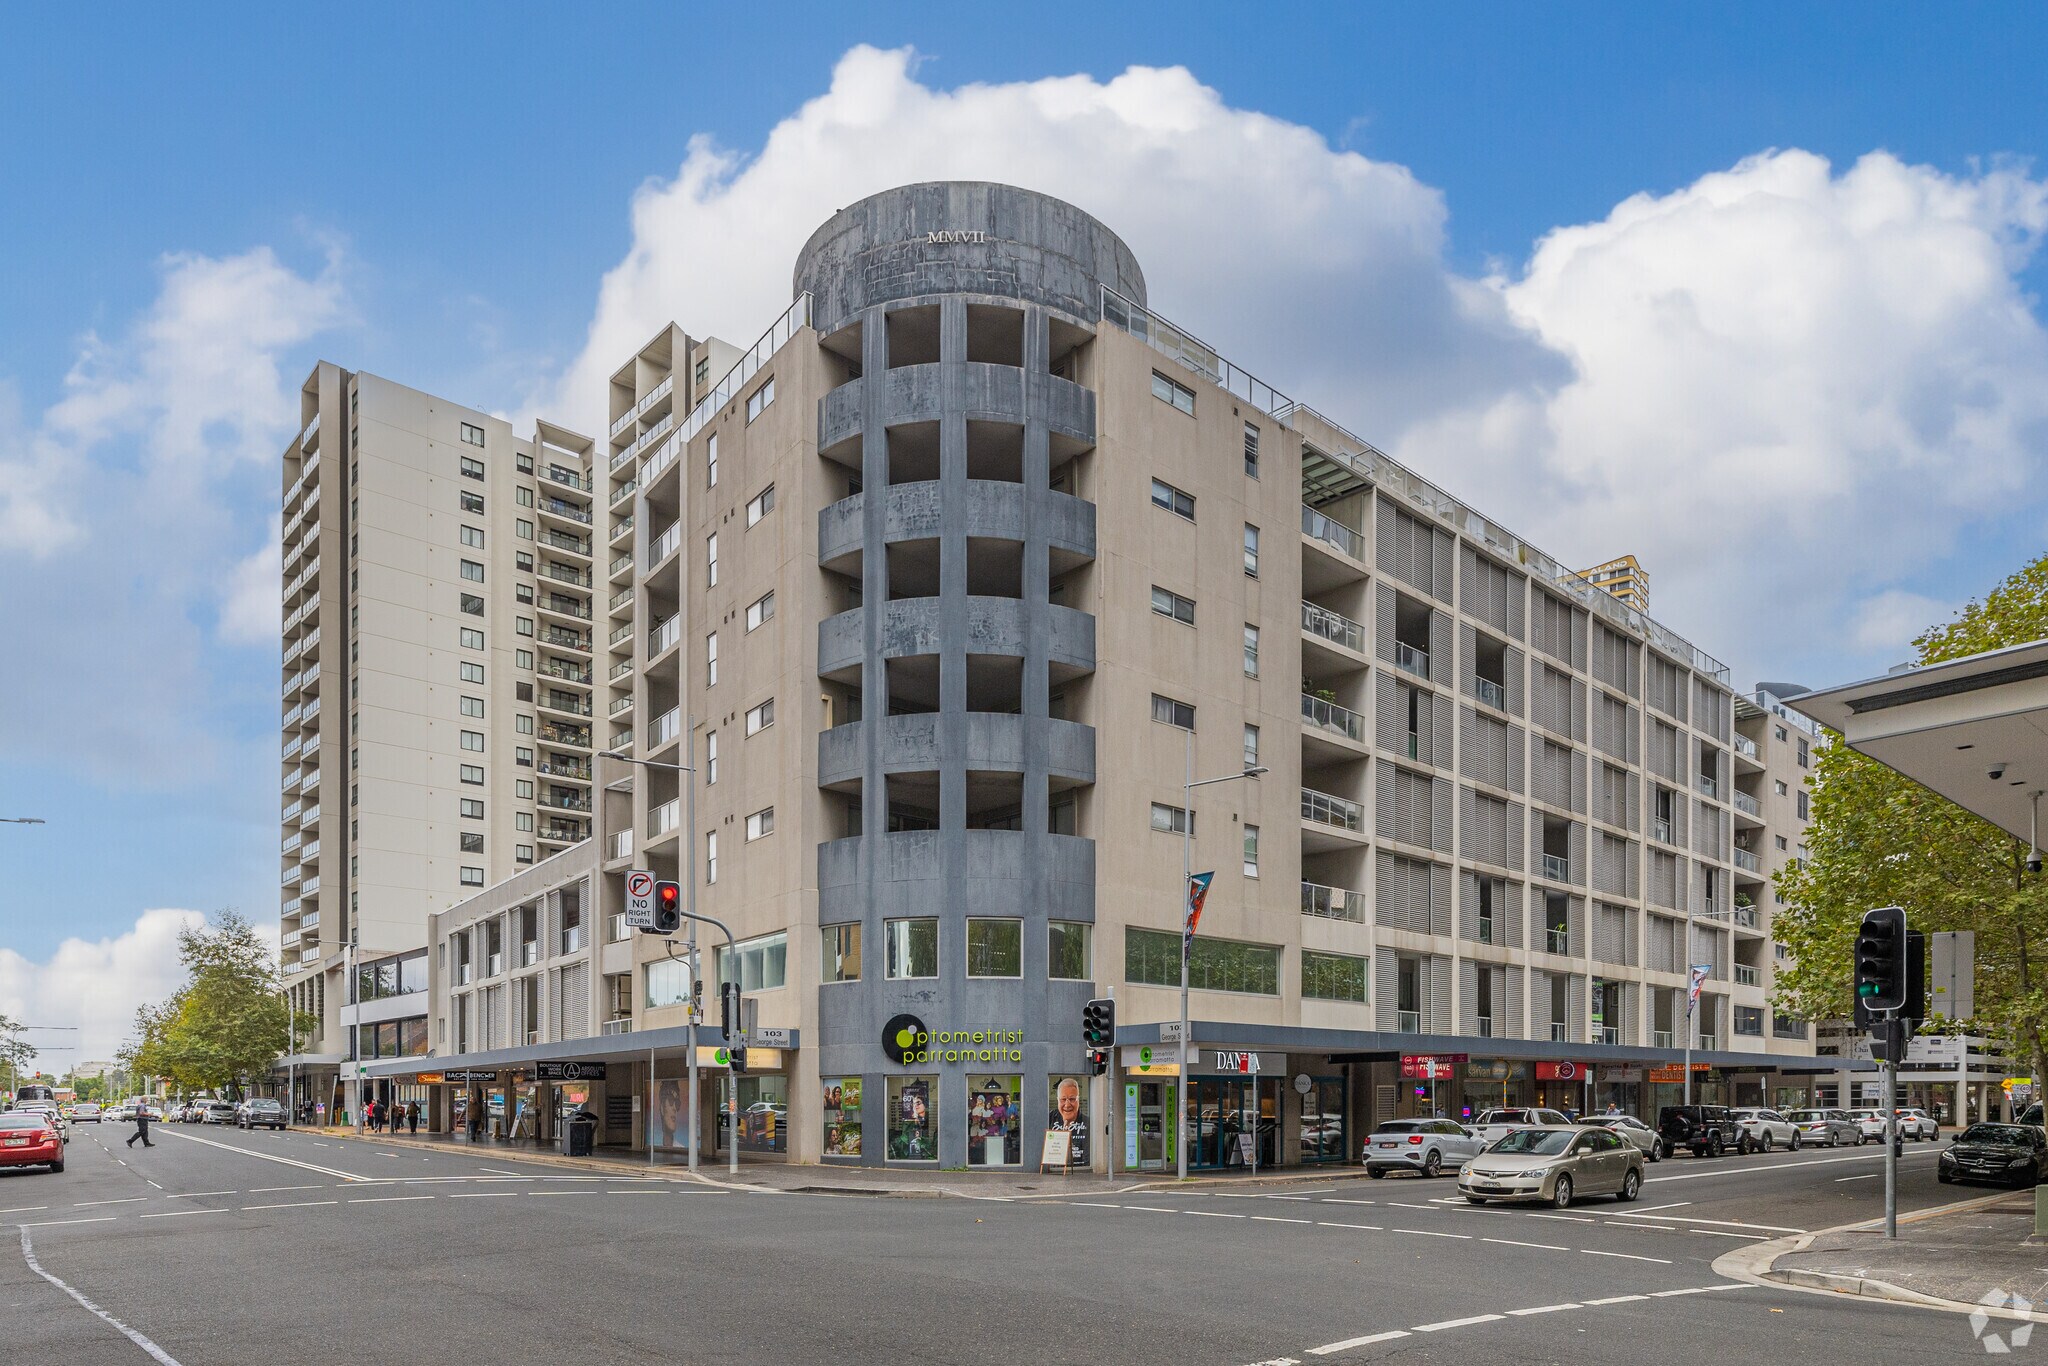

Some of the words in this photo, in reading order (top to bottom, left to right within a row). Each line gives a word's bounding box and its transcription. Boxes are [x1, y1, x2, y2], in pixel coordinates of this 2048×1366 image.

[927, 230, 985, 244] MMVII
[1590, 560, 1628, 575] ALAND
[632, 899, 648, 908] NO
[629, 917, 650, 925] TURN
[756, 1038, 773, 1046] eorge
[1161, 1033, 1176, 1042] George
[903, 1046, 1021, 1065] parramatta
[1216, 1052, 1261, 1070] DANA
[1420, 1063, 1451, 1071] FISWAVE
[1661, 1070, 1685, 1080] DENTIST
